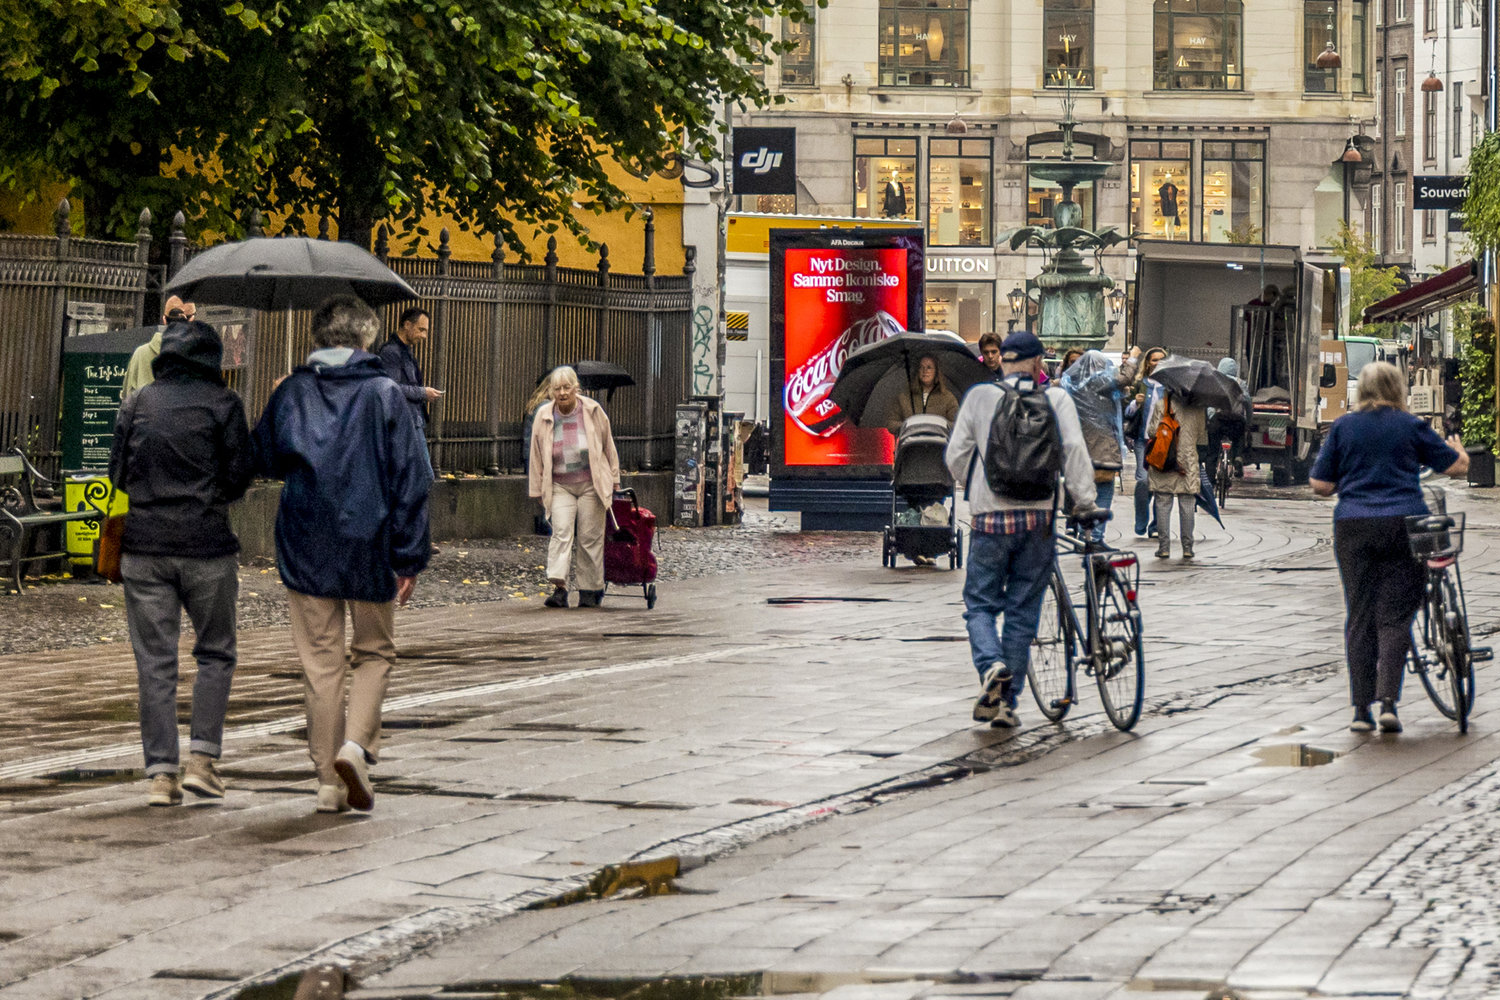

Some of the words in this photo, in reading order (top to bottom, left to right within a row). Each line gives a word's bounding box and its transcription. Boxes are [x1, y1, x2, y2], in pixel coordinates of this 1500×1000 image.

[1189, 37, 1206, 45] HAY
[810, 257, 834, 273] Nyt
[835, 257, 882, 273] Design.
[793, 273, 844, 287] Samme
[845, 273, 900, 287] Ikoniske
[826, 289, 866, 303] Smag.
[84, 365, 98, 378] The
[98, 365, 113, 381] Info
